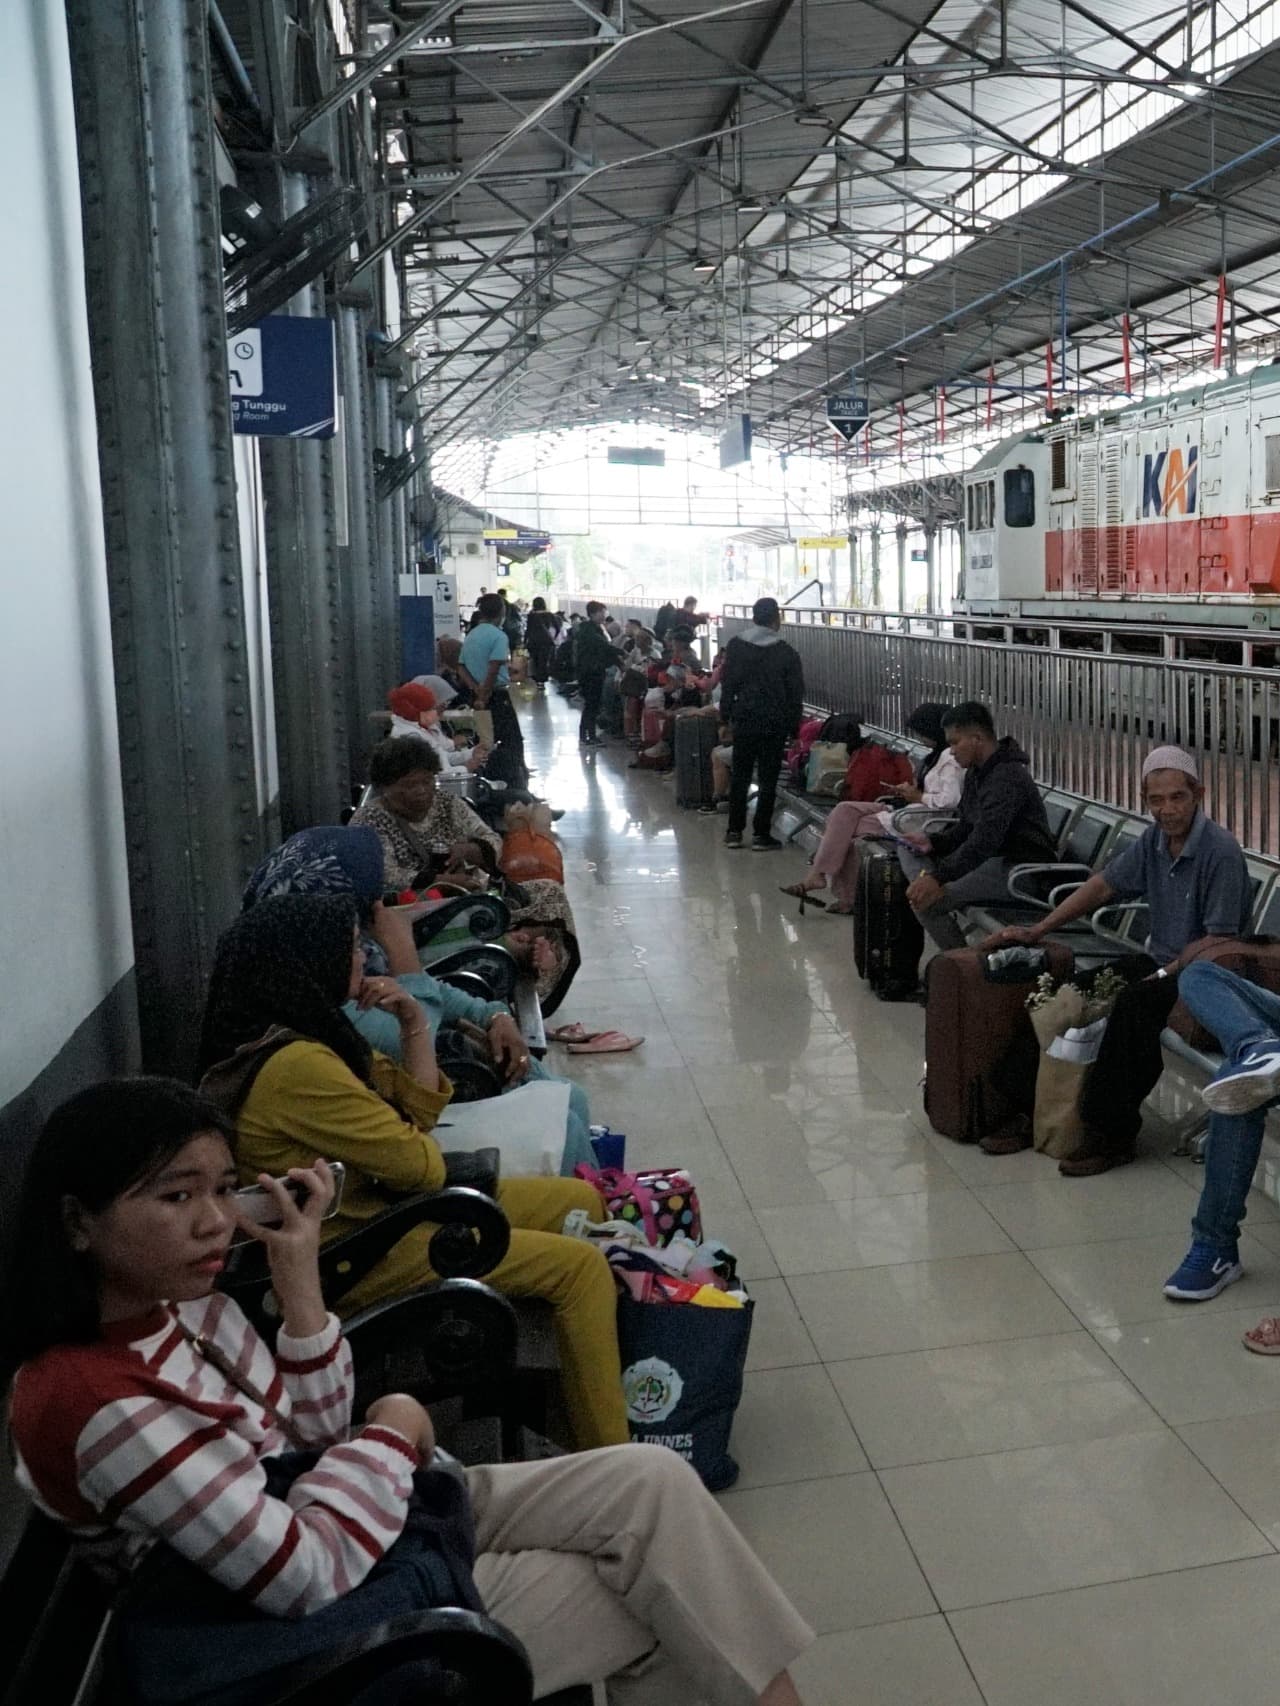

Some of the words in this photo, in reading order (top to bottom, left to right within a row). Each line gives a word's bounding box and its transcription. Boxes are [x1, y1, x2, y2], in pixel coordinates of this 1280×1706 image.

[242, 399, 287, 412] Tunggu
[833, 401, 864, 410] JALUR
[242, 411, 270, 420] Room
[843, 423, 854, 433] 1
[1142, 445, 1198, 517] KAI
